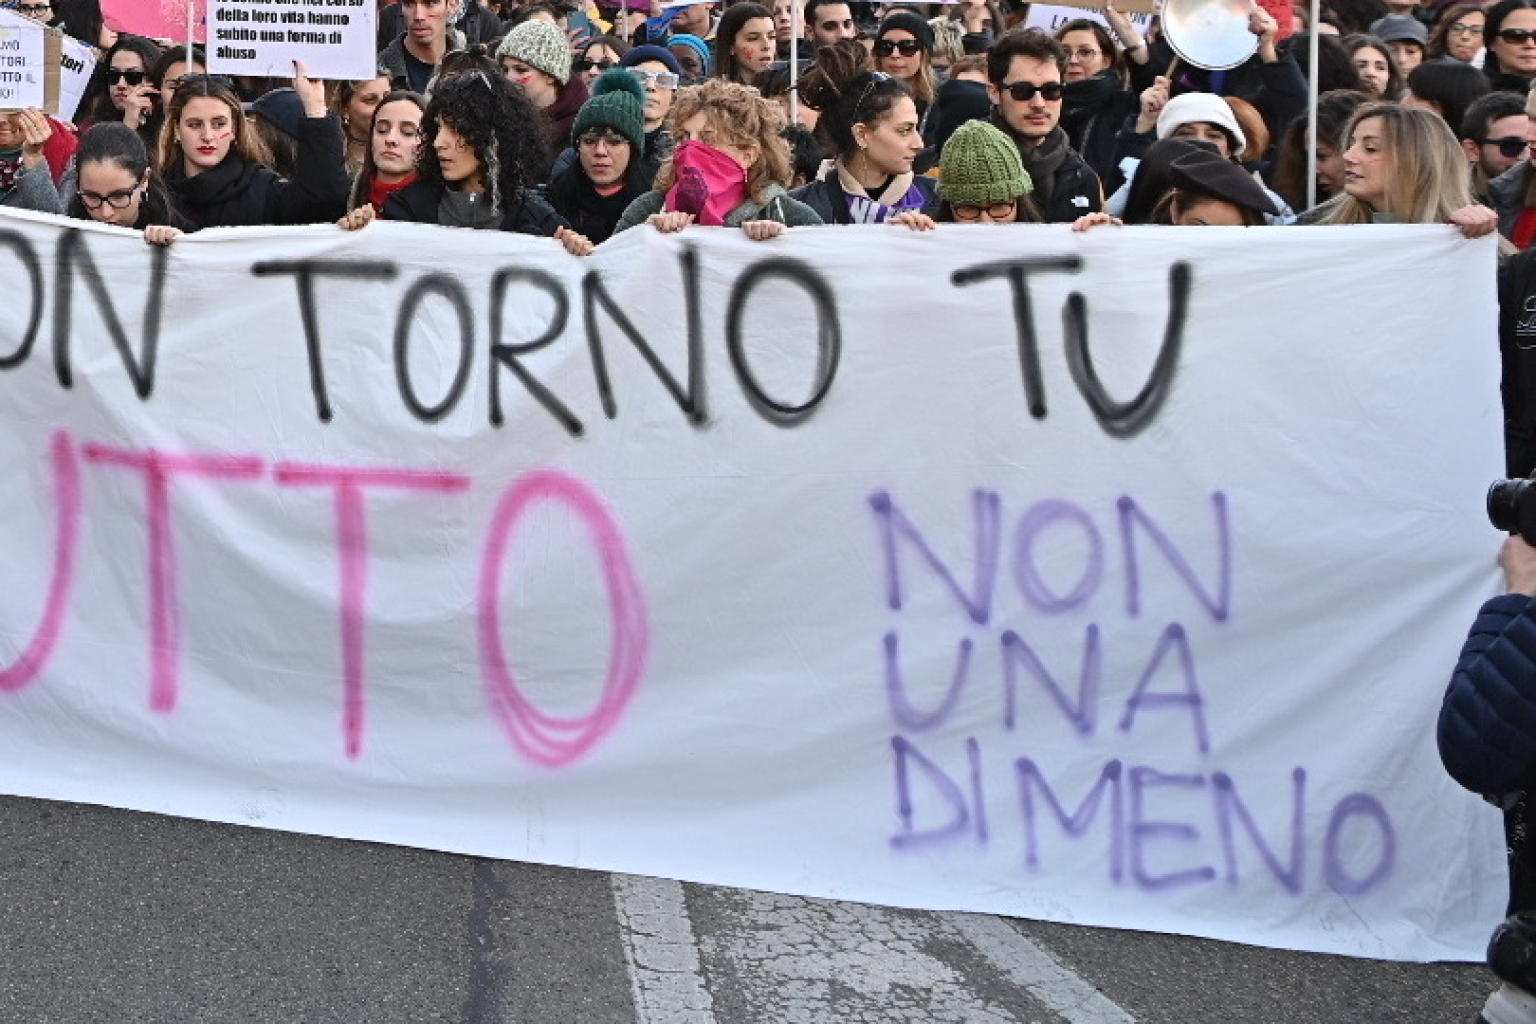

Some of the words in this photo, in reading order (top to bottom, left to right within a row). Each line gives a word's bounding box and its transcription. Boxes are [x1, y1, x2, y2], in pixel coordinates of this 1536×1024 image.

[215, 7, 249, 22] della
[251, 9, 278, 23] loro
[280, 10, 306, 24] vita
[308, 11, 350, 26] hanno
[215, 27, 257, 41] subito
[259, 30, 285, 43] una
[287, 29, 326, 44] forma
[329, 31, 342, 45] di
[215, 45, 257, 60] abuso
[251, 237, 842, 437] TORNO
[949, 255, 1193, 439] TU
[866, 487, 1233, 627] NON
[881, 622, 1212, 757] UNA
[887, 733, 989, 852] DI
[1013, 756, 1398, 900] MENO
